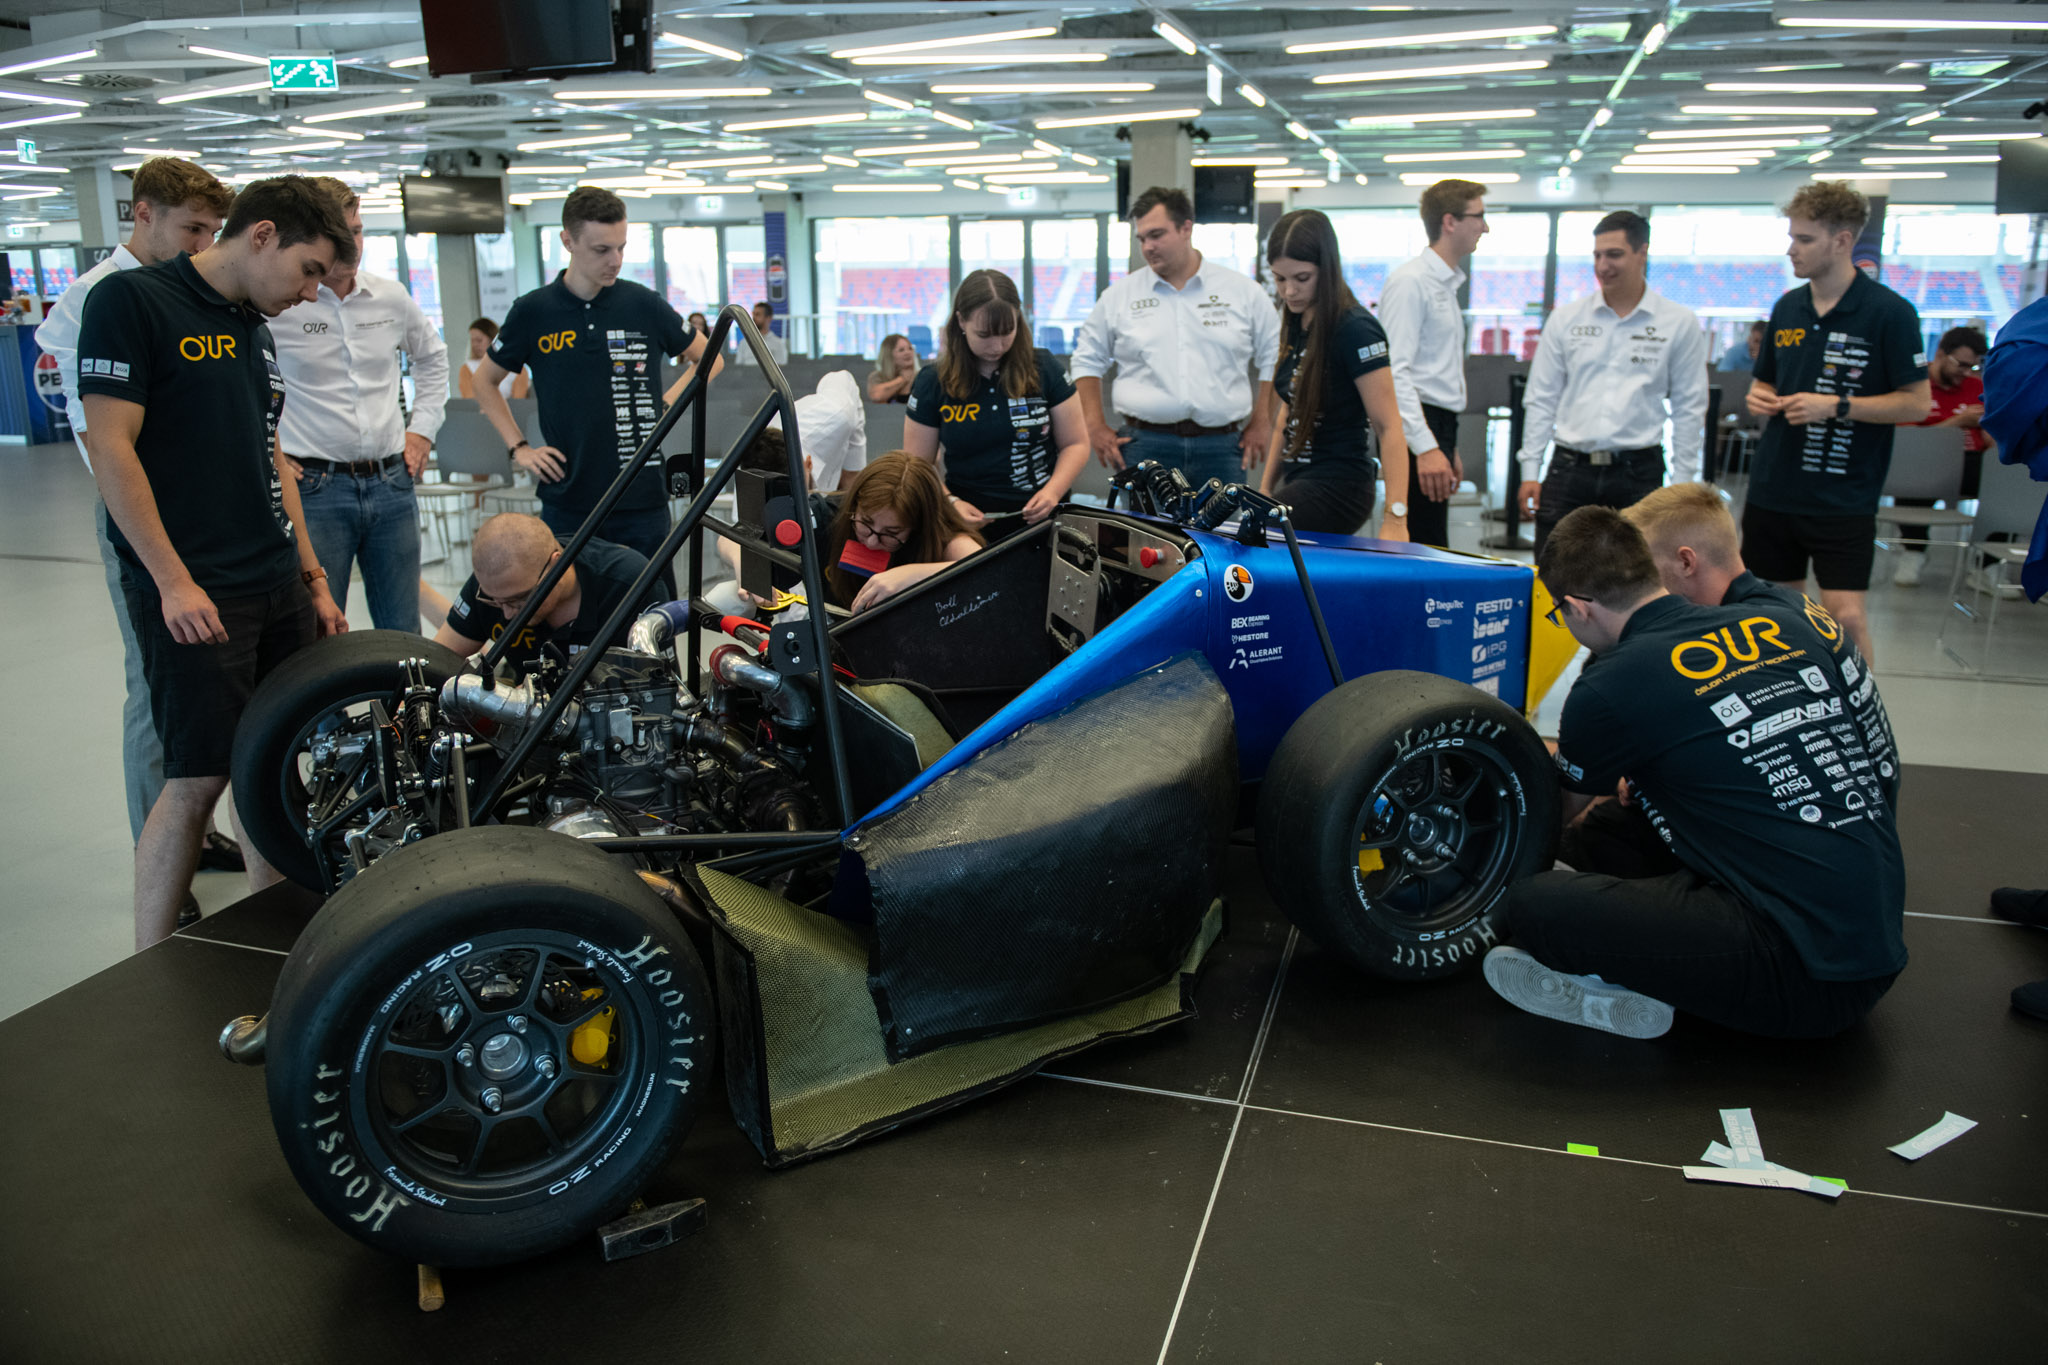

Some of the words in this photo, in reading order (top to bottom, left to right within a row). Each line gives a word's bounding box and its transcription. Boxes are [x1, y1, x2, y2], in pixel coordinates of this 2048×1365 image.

[1248, 614, 1270, 623] BEARING
[1475, 598, 1513, 615] FESTO
[1231, 617, 1249, 629] BEX
[1238, 632, 1269, 642] HESTORE
[1249, 646, 1283, 659] ALERANT
[1394, 708, 1507, 758] Hoosier
[1403, 742, 1434, 761] RACING
[1767, 754, 1792, 768] Hydro
[1768, 765, 1799, 785] AVIS
[1448, 916, 1478, 936] RACING
[576, 939, 608, 962] Student
[1392, 915, 1498, 976] Hoosier
[606, 955, 634, 984] Formula
[380, 970, 422, 1014] RACING
[613, 935, 705, 1095] Hoosier
[354, 1025, 377, 1073] MAGNESIUM
[635, 1072, 656, 1117] MAGNESIUM
[1726, 1114, 1745, 1145] POWER
[299, 1063, 410, 1232] Hoosier
[594, 1127, 632, 1167] RACING
[383, 1165, 415, 1192] Formula
[412, 1186, 447, 1207] Student
